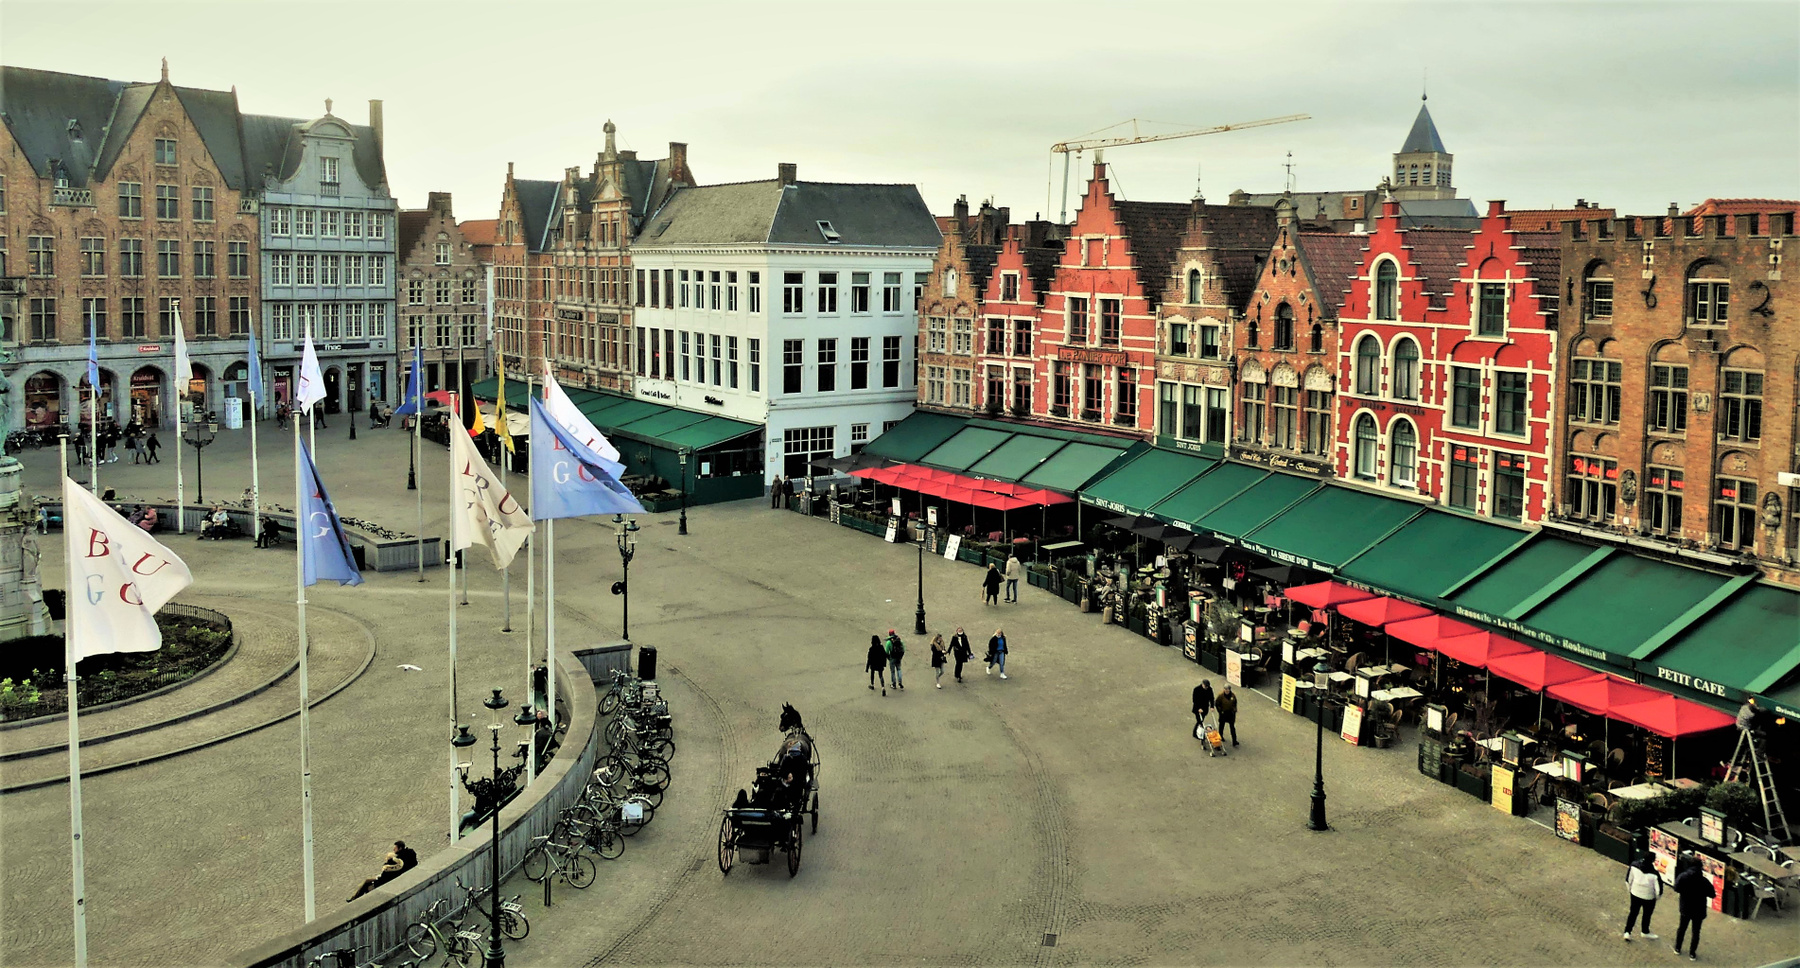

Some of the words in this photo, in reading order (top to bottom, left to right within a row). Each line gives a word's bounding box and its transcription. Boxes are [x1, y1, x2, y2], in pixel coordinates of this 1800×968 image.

[1073, 350, 1103, 363] PANIER
[1176, 441, 1187, 449] SINT
[1187, 443, 1201, 451] JORIS
[1657, 666, 1692, 686] PETIT
[1694, 678, 1726, 697] CAFE
